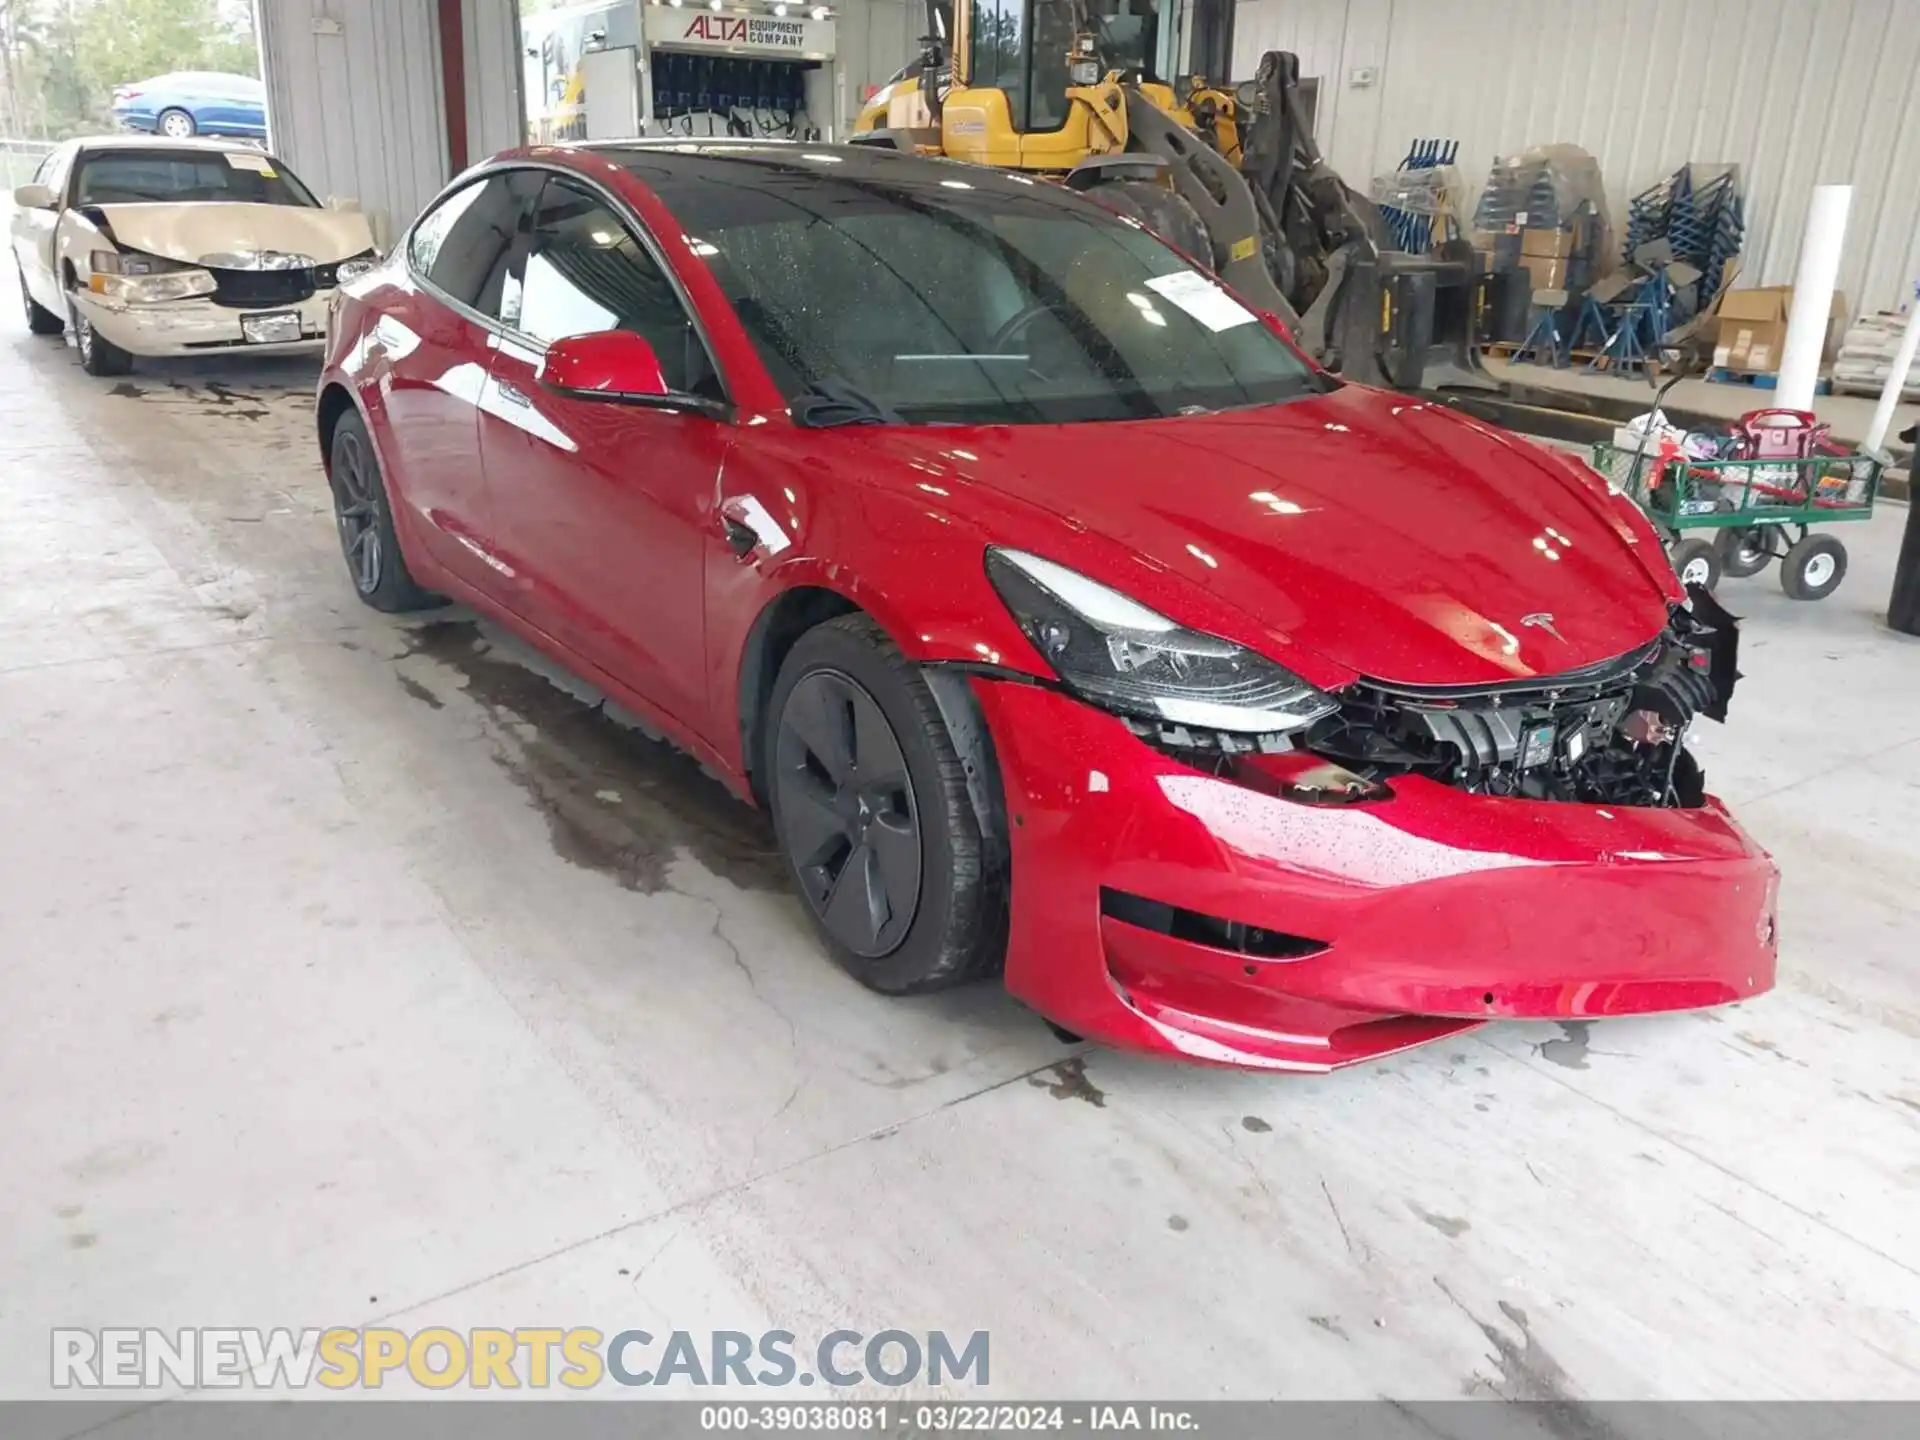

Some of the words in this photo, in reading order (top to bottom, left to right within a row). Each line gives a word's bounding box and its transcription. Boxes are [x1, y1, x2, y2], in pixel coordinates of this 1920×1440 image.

[683, 15, 747, 42] ALTA
[749, 19, 803, 34] EQUIPMENT
[749, 31, 803, 48] COMPANY
